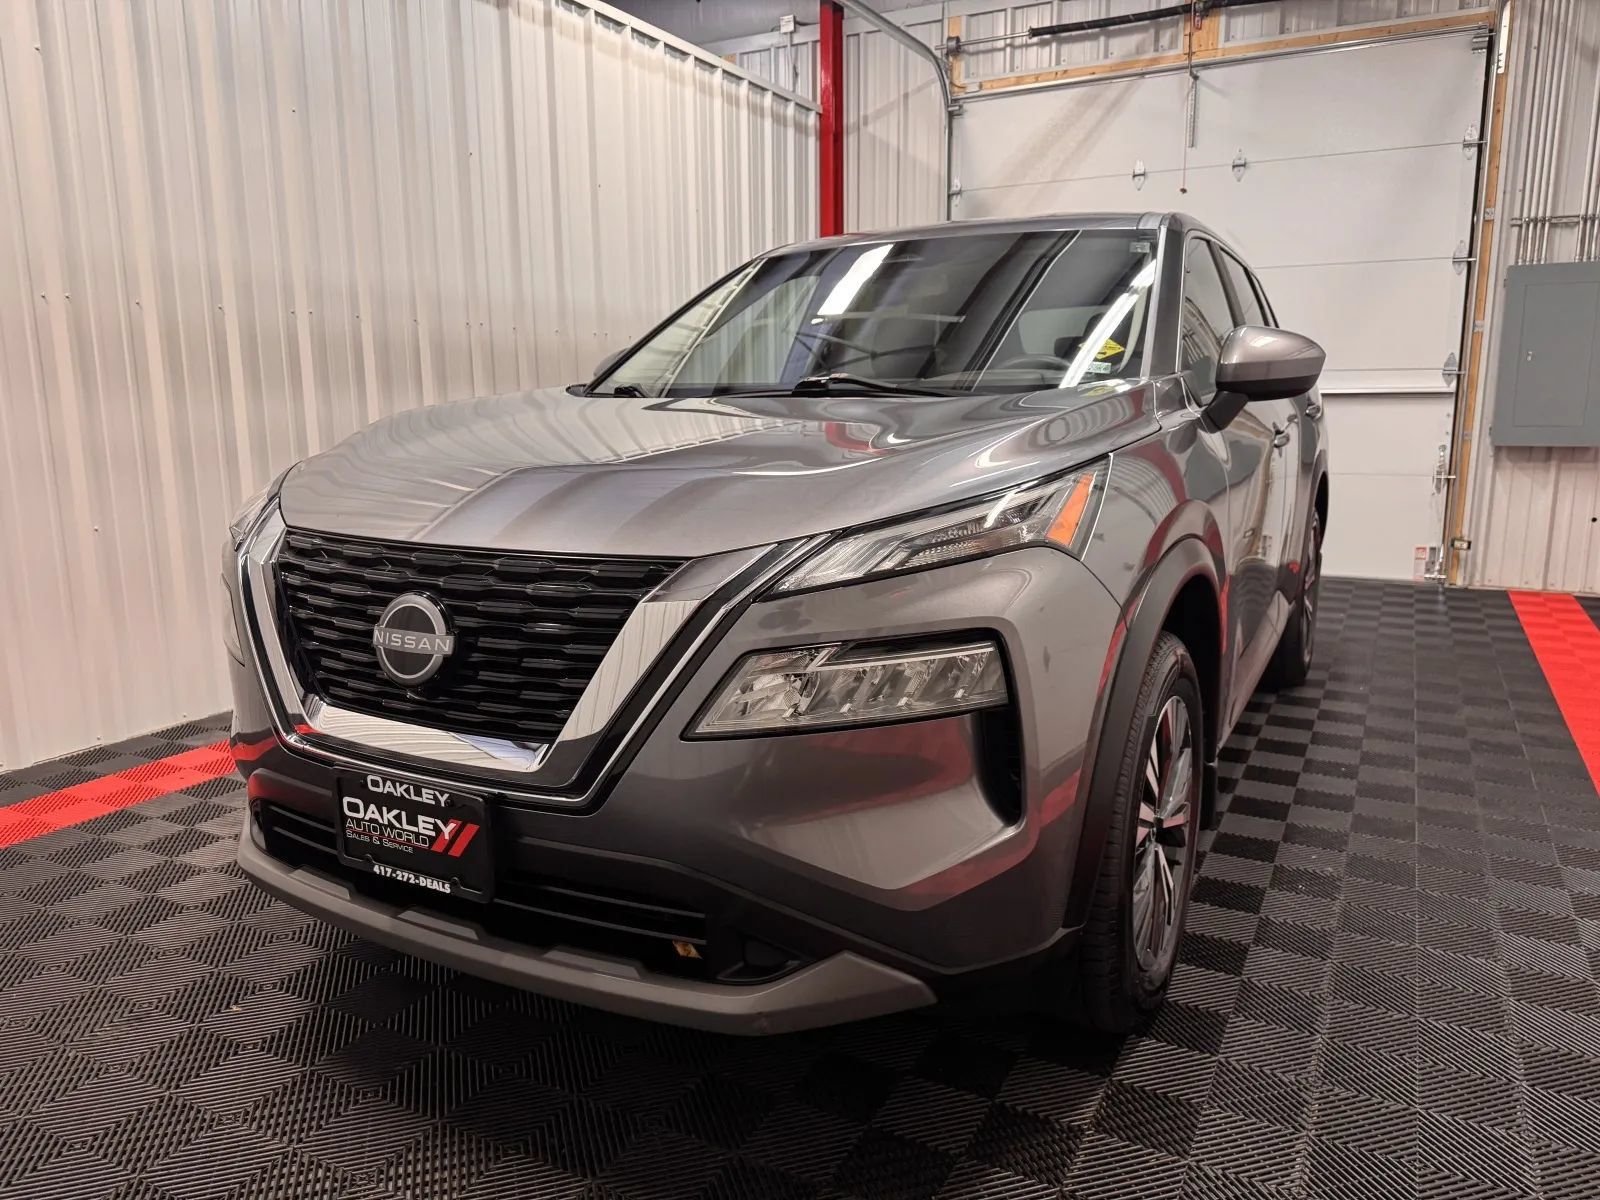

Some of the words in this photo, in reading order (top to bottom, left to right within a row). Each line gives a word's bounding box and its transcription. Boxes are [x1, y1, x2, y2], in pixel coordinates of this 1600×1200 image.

[374, 629, 450, 652] NISSAN
[366, 774, 450, 807] OAKLEY
[342, 796, 457, 840] OAKLEY
[345, 818, 380, 835] AUTO
[382, 825, 429, 847] WORLD
[372, 836, 380, 845] &
[373, 864, 451, 894] 417-272-DEALS
